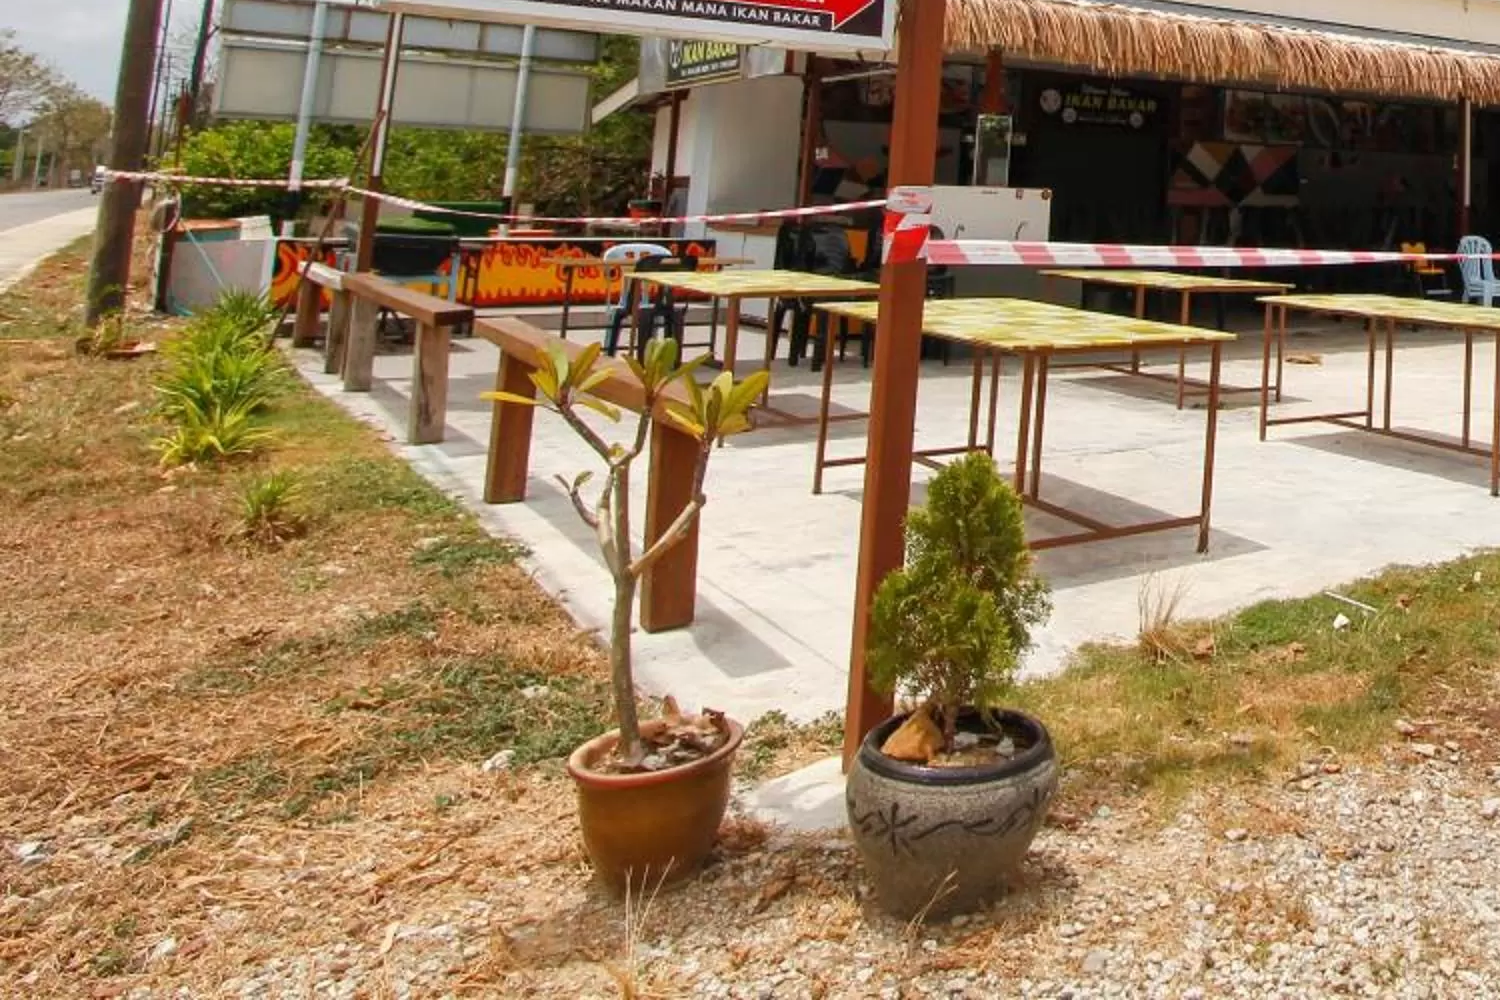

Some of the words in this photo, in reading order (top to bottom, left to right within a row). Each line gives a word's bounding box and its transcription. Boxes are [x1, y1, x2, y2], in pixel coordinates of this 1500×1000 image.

[681, 0, 728, 18] MANA
[732, 5, 770, 21] IKAN
[773, 11, 822, 28] BAKAR
